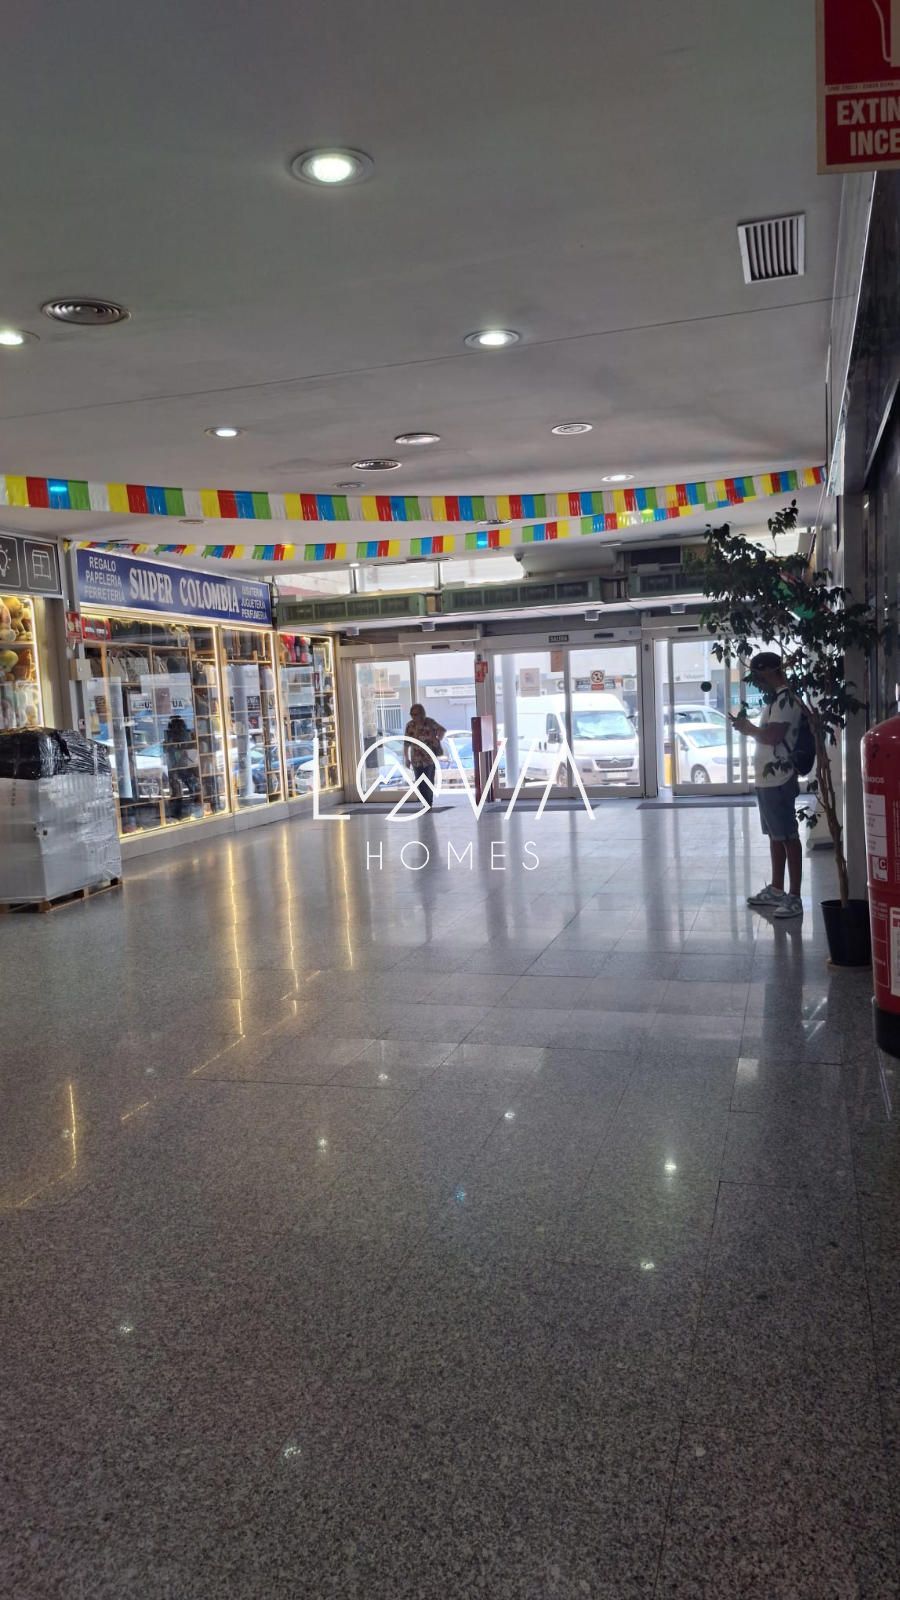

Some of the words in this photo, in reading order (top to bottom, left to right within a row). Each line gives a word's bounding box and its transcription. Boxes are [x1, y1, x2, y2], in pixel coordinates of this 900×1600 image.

[836, 96, 900, 126] EXTIN
[849, 128, 900, 157] INCE
[89, 556, 117, 572] REGALO
[129, 567, 174, 605] SUPER
[180, 577, 240, 613] COLOMBIA
